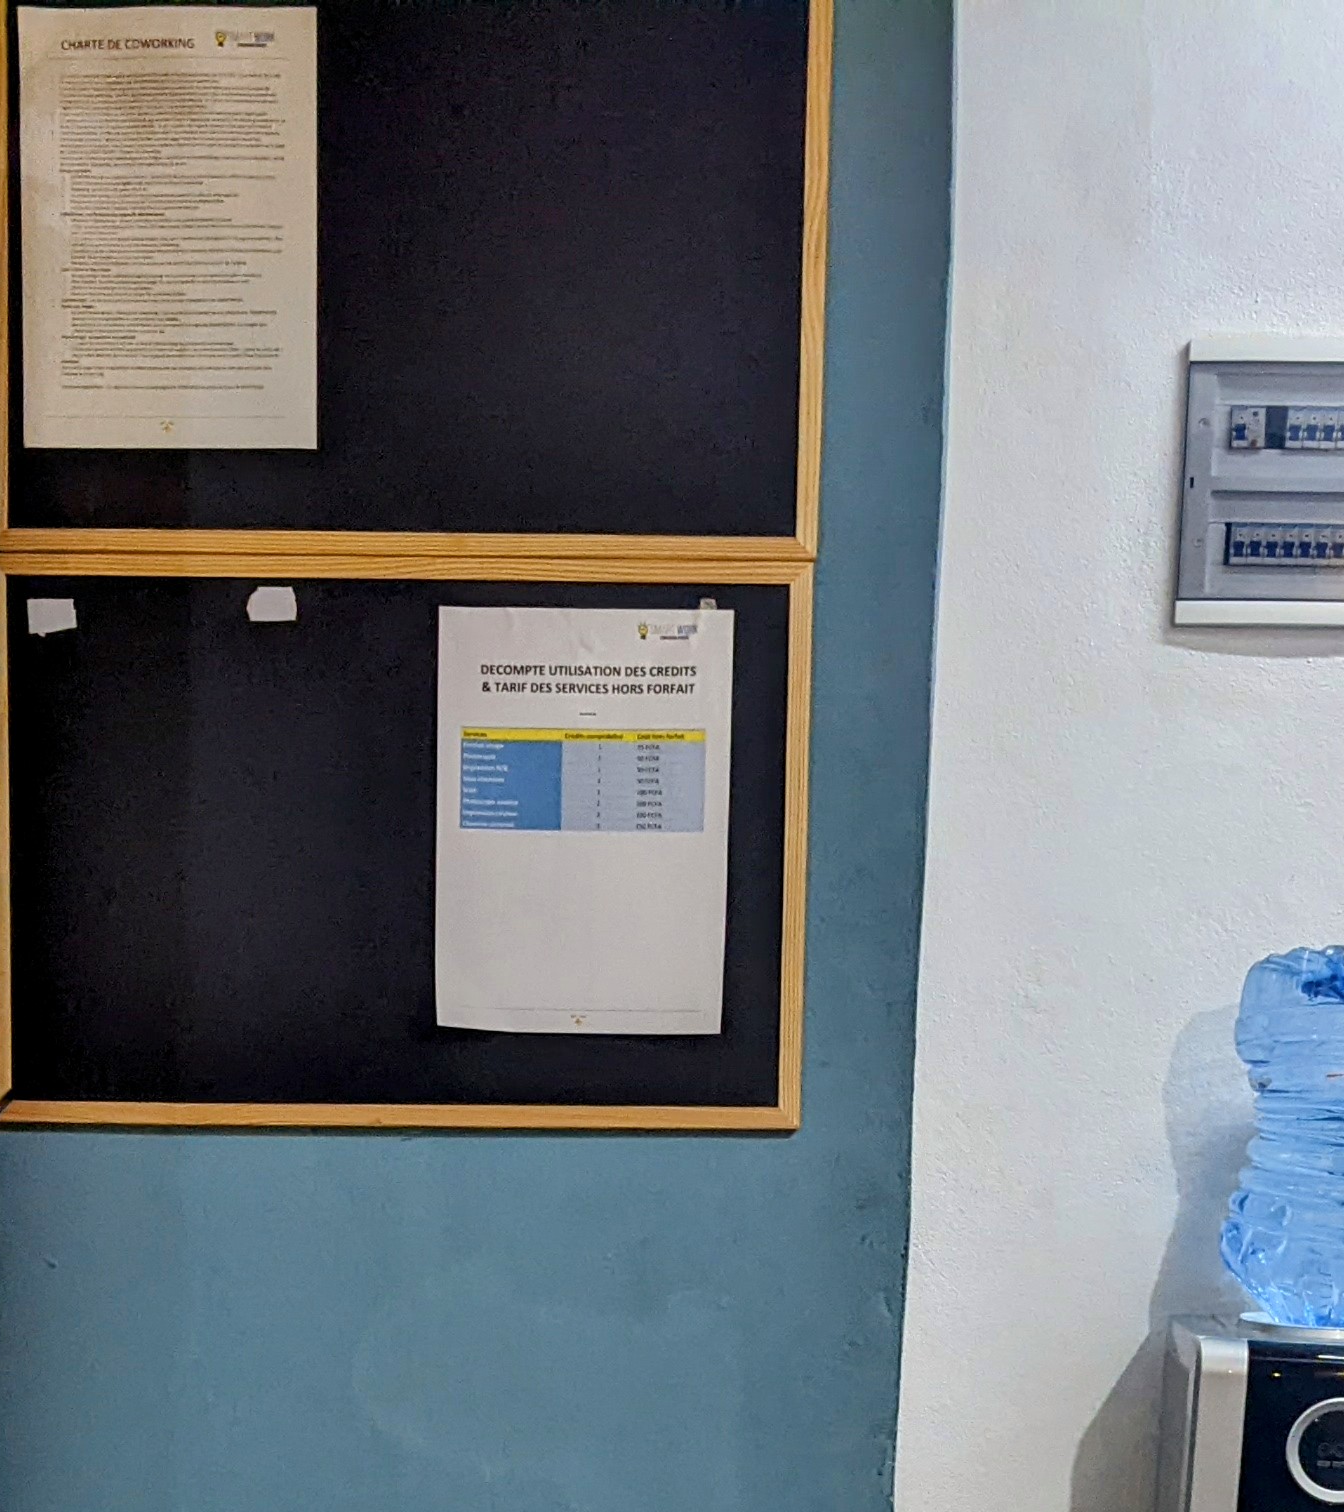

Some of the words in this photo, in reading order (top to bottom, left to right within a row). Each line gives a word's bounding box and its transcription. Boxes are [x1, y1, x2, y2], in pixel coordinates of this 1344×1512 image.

[61, 39, 105, 51] CHARTE
[108, 39, 121, 50] DE
[124, 38, 196, 50] COWORKING
[480, 664, 546, 677] DECOMPTE
[548, 665, 621, 678] UTILISATION
[625, 666, 646, 678] DES
[649, 666, 697, 678] CREDITS
[482, 681, 491, 693] &
[494, 682, 527, 693] TARIF
[530, 682, 552, 694] DES
[555, 683, 607, 695] SERVICES
[611, 684, 644, 695] HORS
[647, 684, 695, 695] FORFAIT
